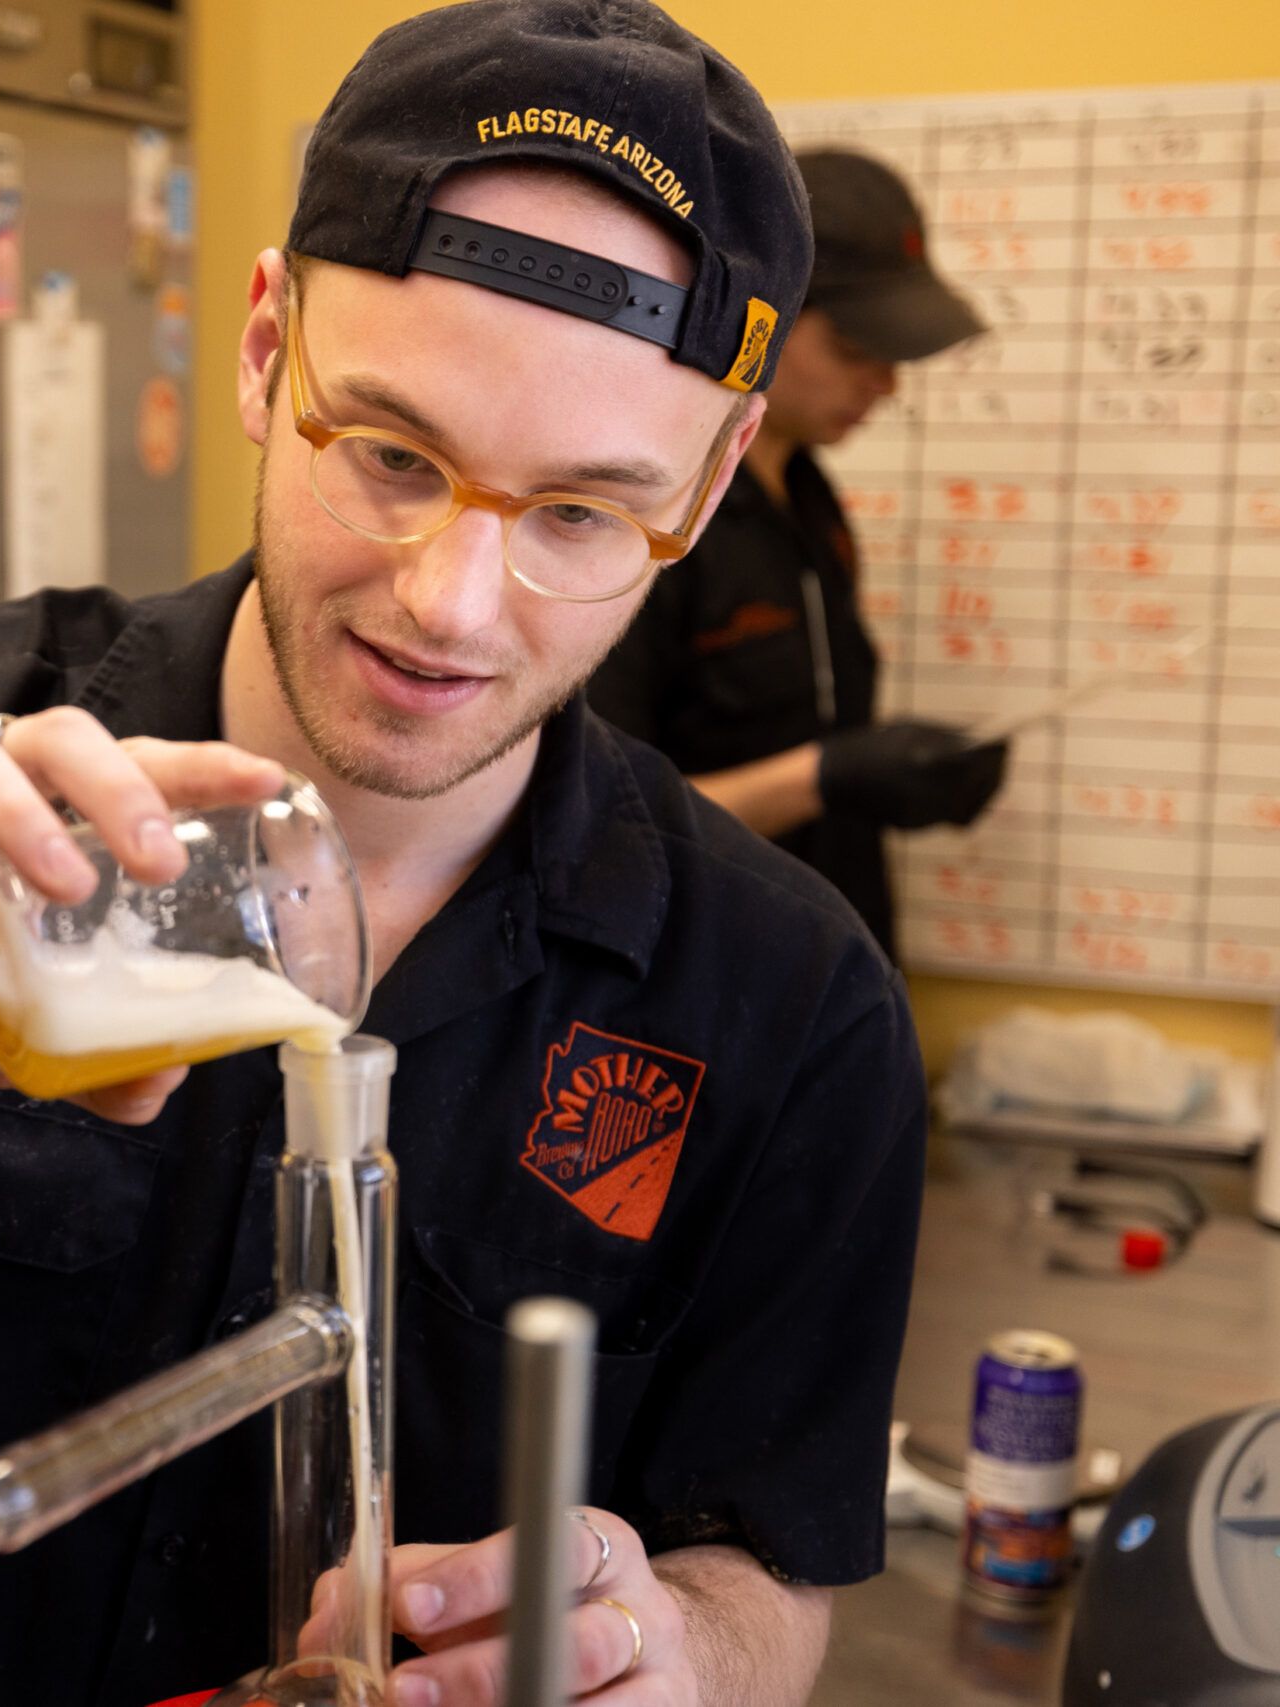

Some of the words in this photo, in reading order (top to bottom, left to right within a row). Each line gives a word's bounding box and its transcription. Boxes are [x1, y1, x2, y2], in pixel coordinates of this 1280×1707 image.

[611, 136, 694, 219] ARIZONA
[552, 1053, 684, 1133] MOTHER
[581, 1091, 652, 1176] ROAD
